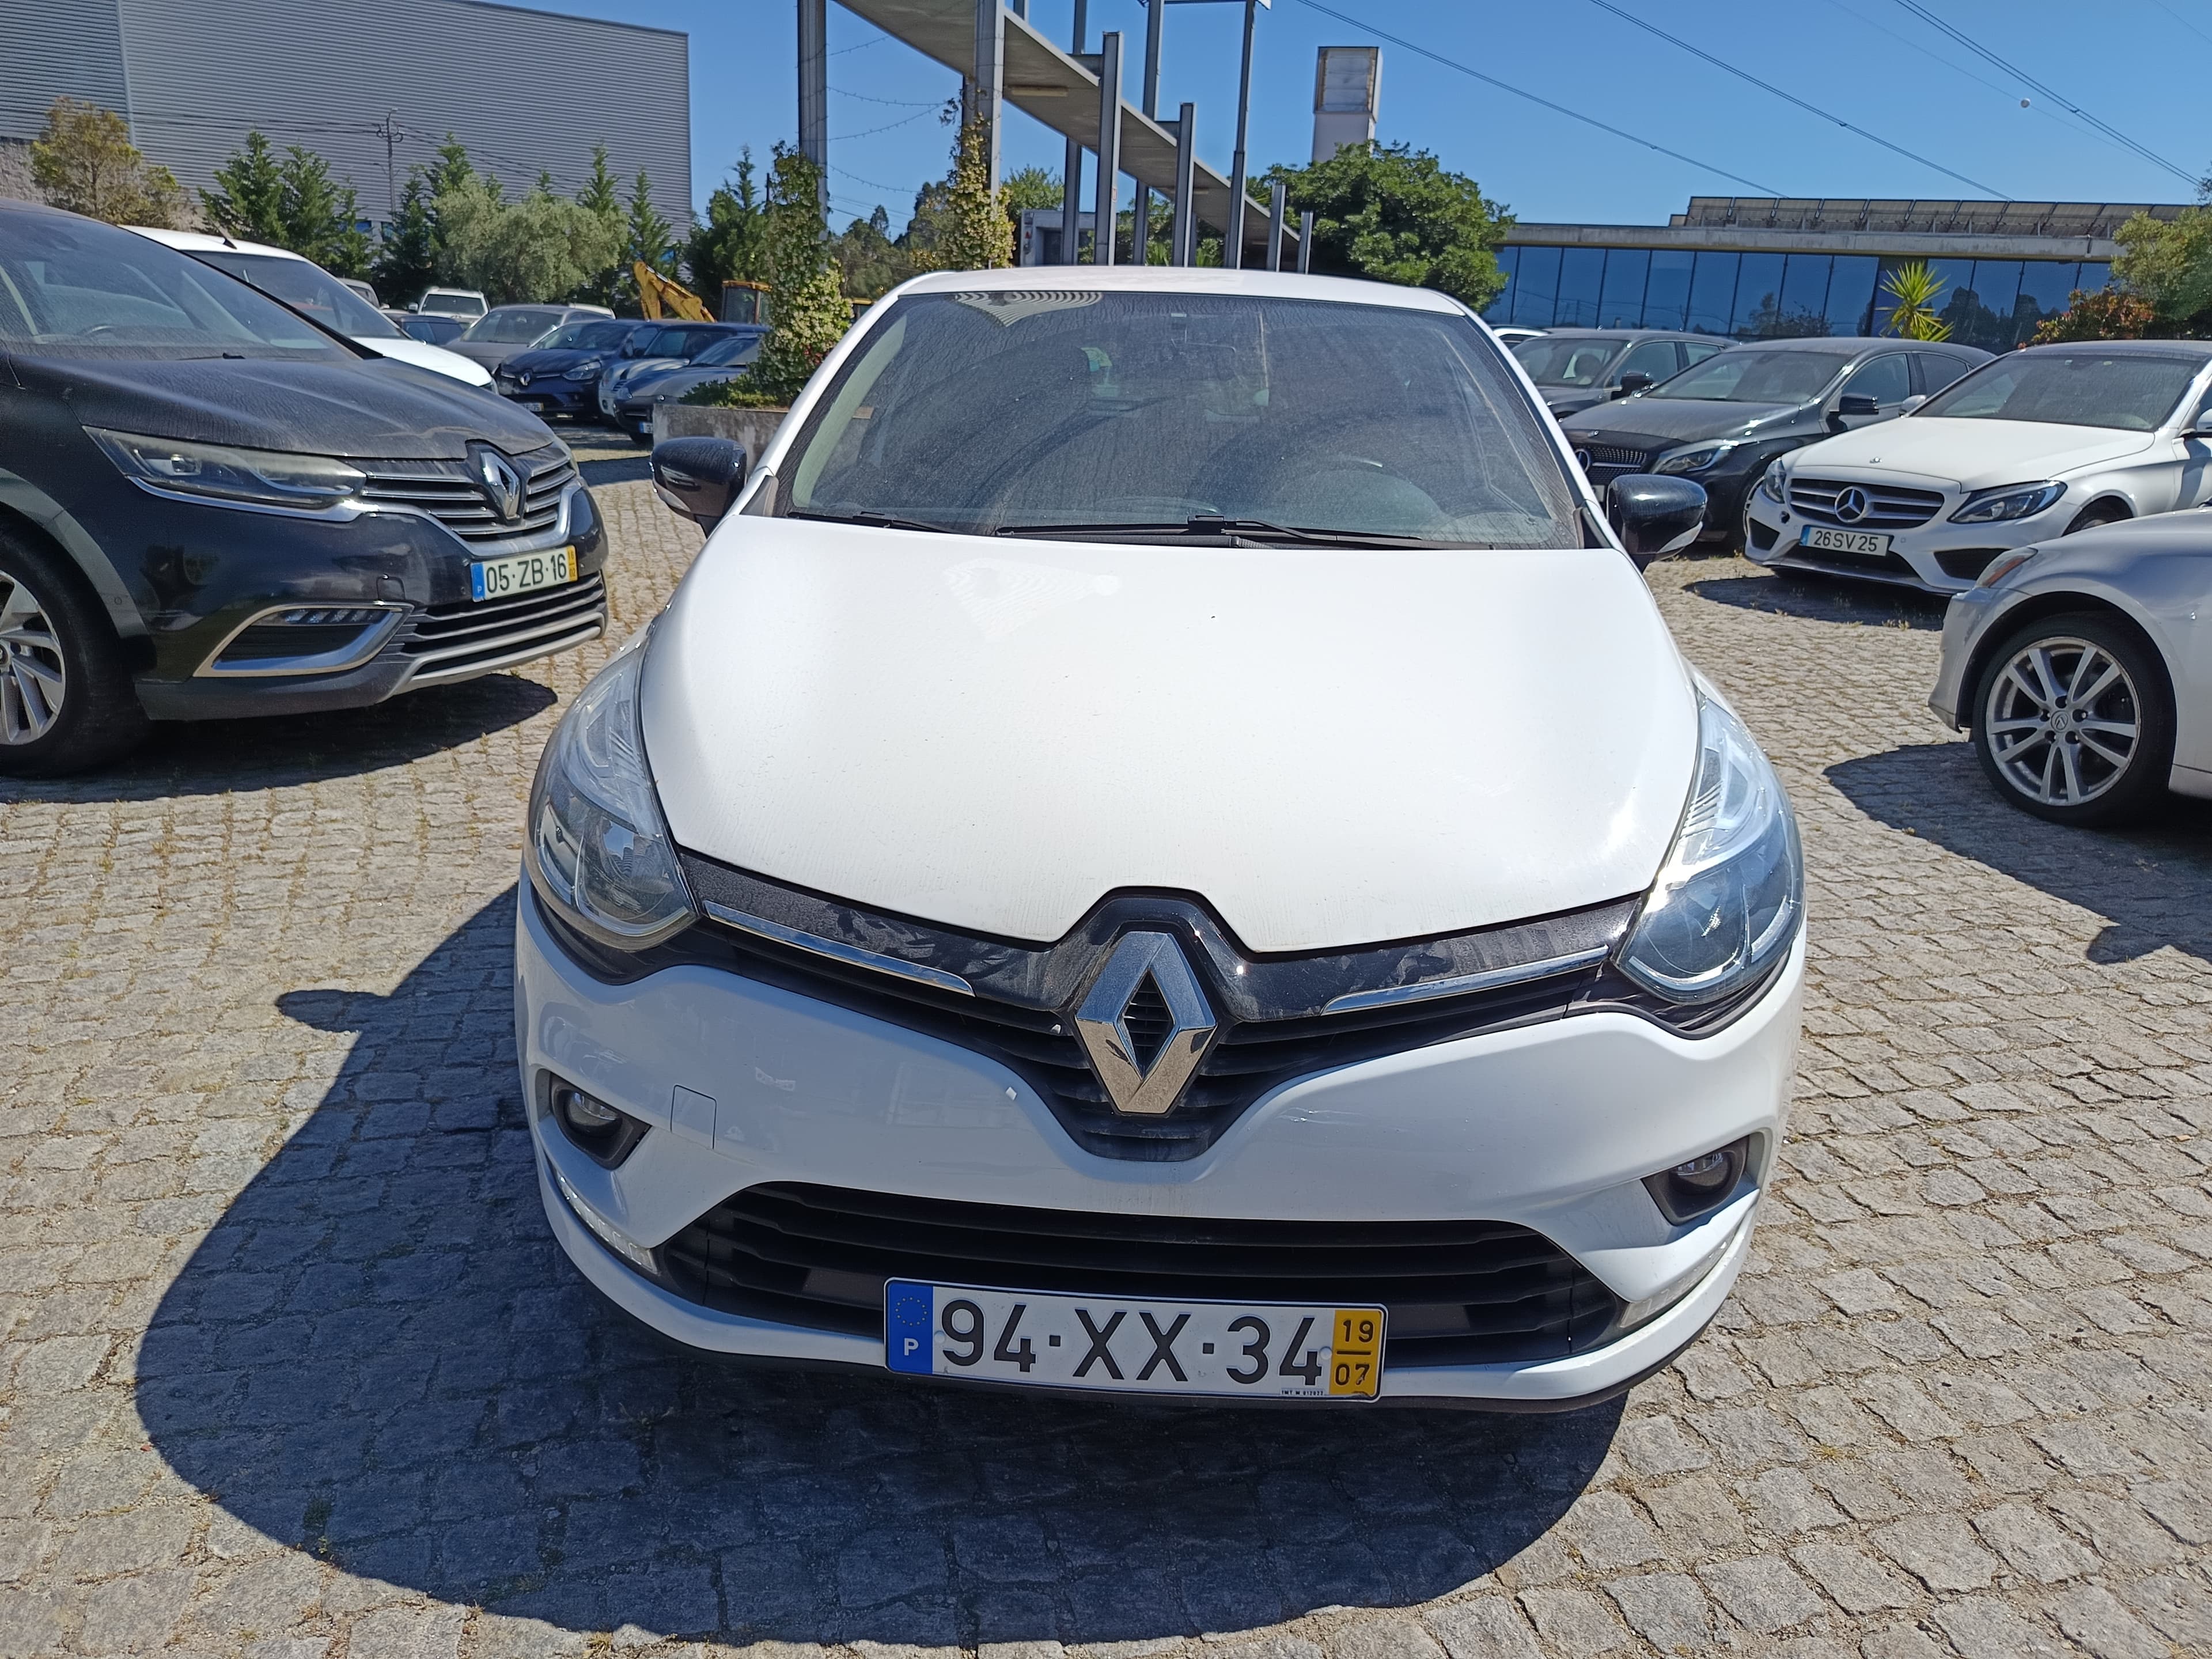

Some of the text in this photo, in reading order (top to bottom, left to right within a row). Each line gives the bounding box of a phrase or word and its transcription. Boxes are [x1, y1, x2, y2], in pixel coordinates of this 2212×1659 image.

[477, 585, 482, 593] P
[1343, 1320, 1374, 1343] 19
[904, 1338, 919, 1356] P
[1335, 1363, 1370, 1385] 07
